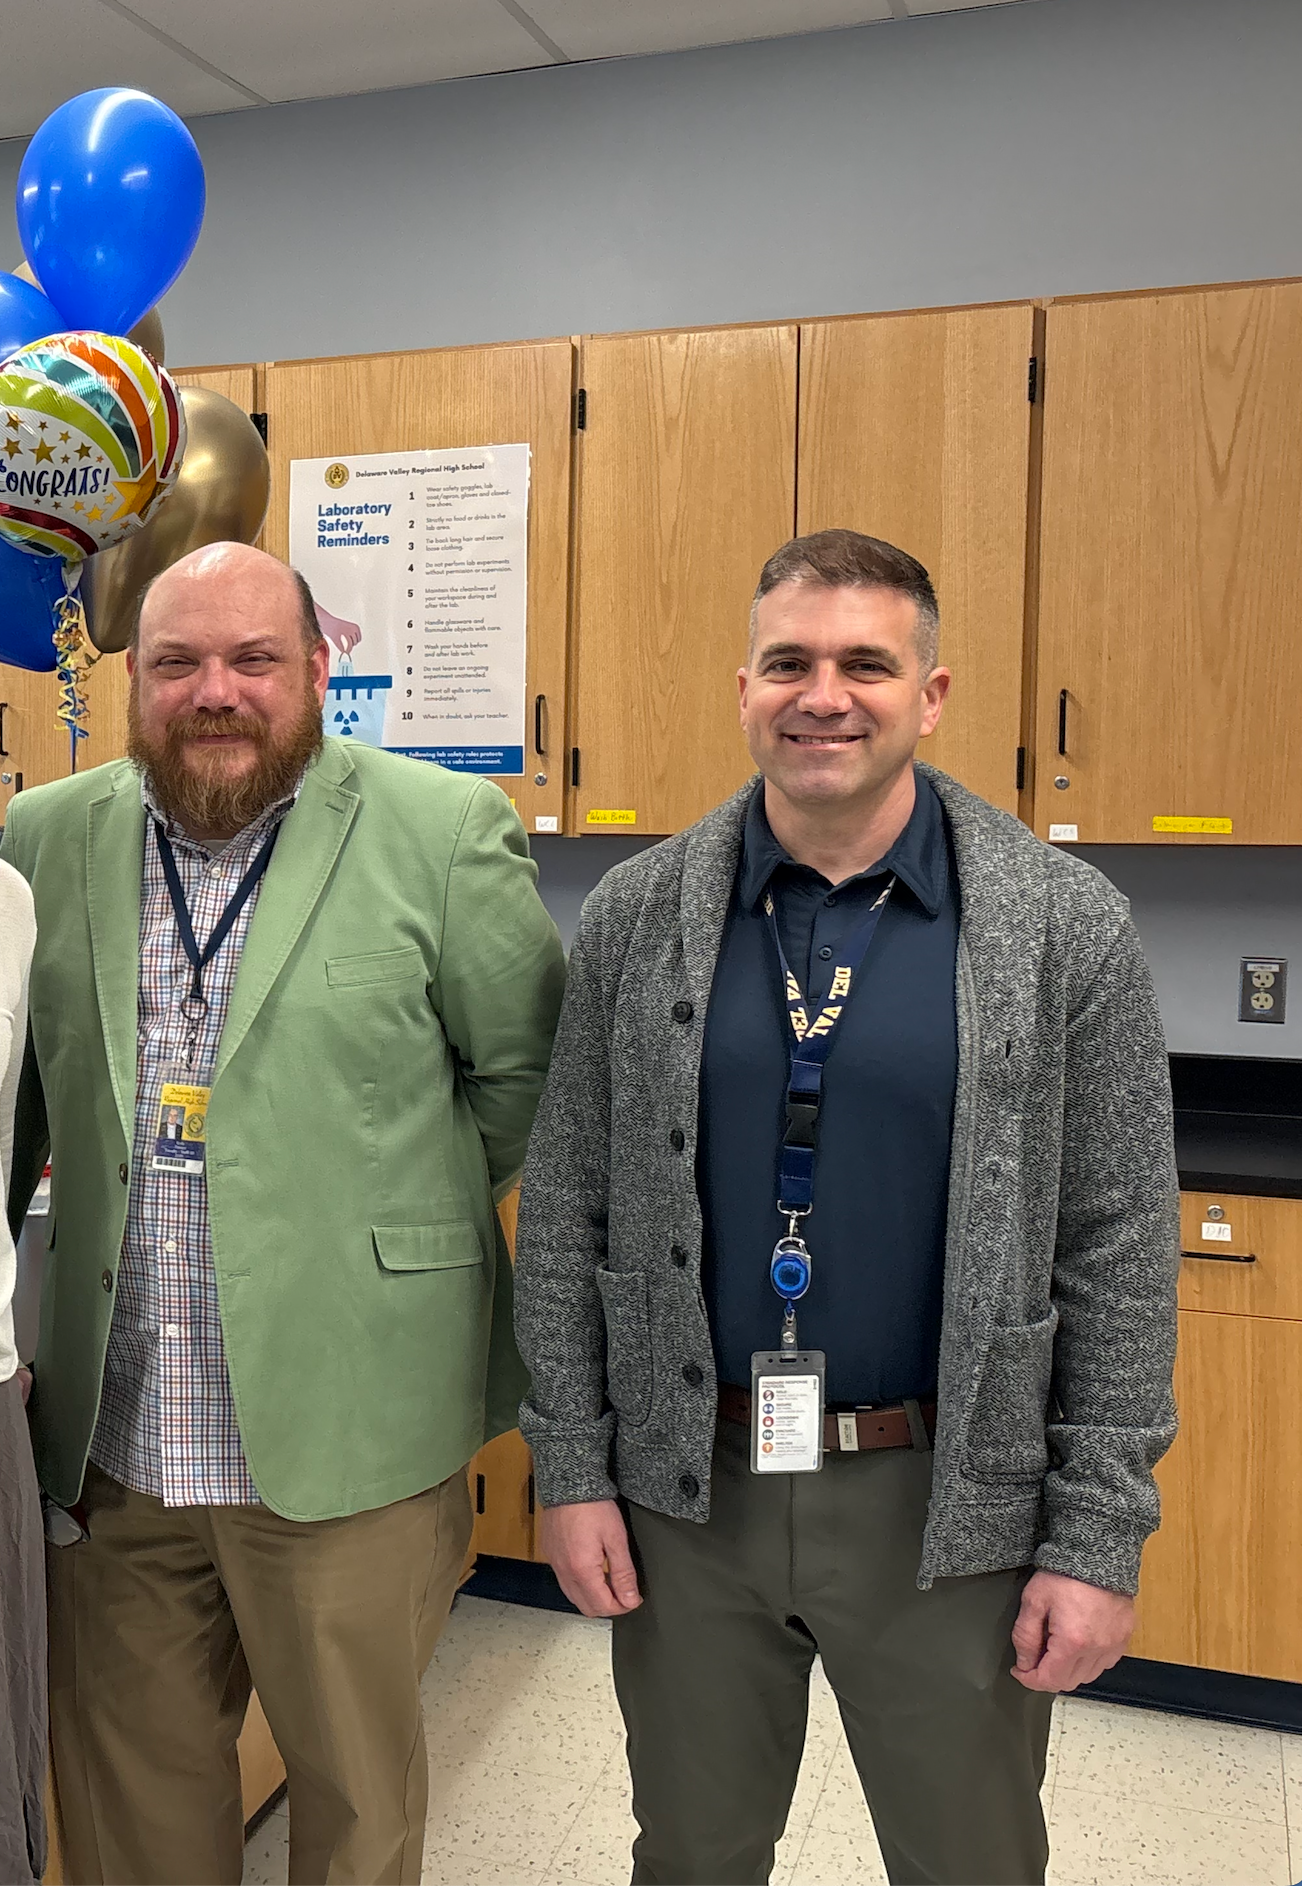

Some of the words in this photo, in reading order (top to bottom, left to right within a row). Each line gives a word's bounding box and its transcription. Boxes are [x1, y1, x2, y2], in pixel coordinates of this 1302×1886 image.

[355, 470, 387, 478] Delaware
[390, 468, 410, 477] Valley
[411, 465, 442, 475] Regional
[444, 464, 460, 473] High
[461, 463, 485, 471] School
[409, 492, 415, 500] 1
[461, 491, 478, 500] gloves
[318, 503, 392, 517] Laboratory
[317, 519, 363, 533] Safety
[408, 520, 414, 528] 2
[317, 533, 390, 548] Reminders
[450, 536, 462, 544] long
[408, 542, 414, 550] 3
[407, 563, 414, 572] 4
[446, 568, 473, 576] permission
[407, 589, 413, 598] 5
[407, 620, 413, 628] 6
[407, 645, 413, 653] 7
[406, 667, 412, 675] 8
[406, 689, 412, 697] 9
[402, 712, 413, 720] 10
[409, 751, 436, 759] Following
[828, 966, 852, 1000] DEL
[805, 1005, 843, 1038] VAL
